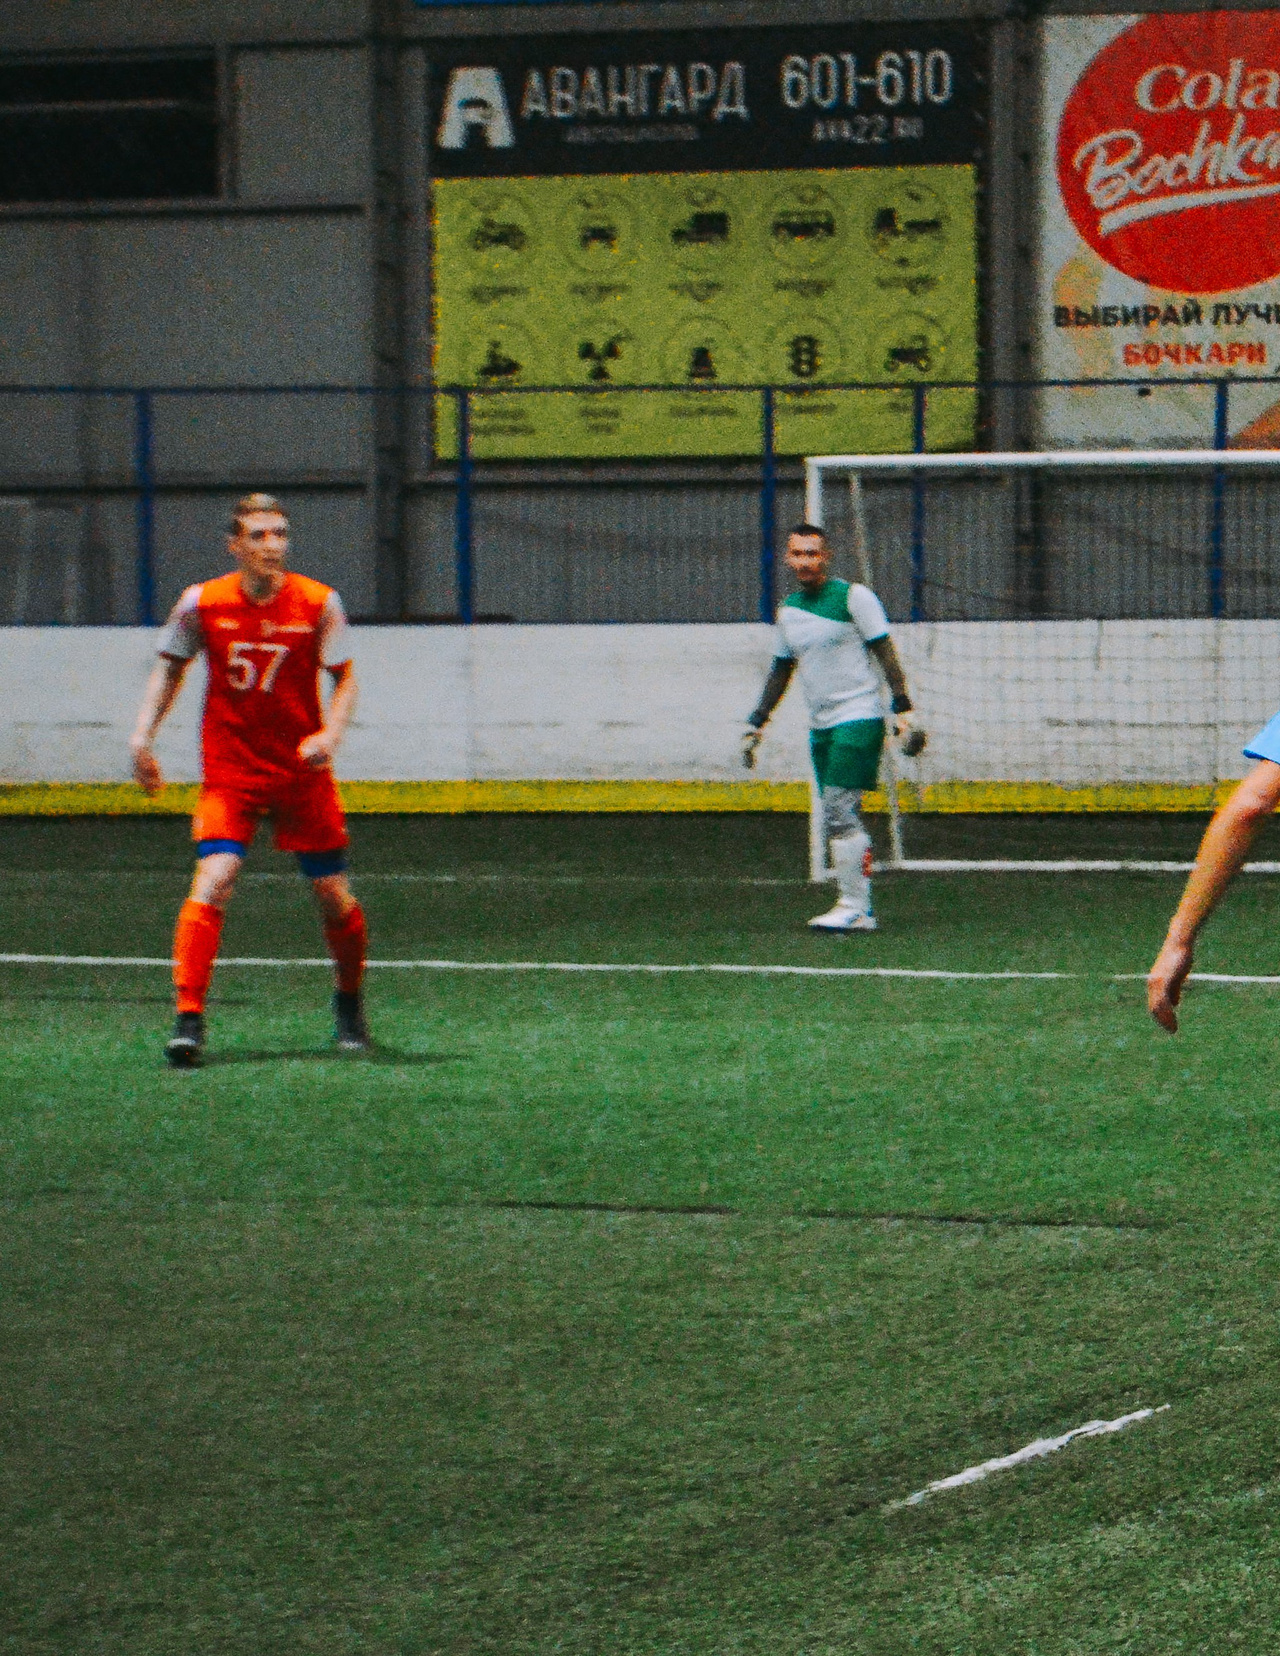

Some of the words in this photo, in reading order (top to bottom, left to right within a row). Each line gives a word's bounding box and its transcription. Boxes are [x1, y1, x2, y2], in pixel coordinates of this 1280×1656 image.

[521, 61, 748, 121] АВАНГАРД
[781, 49, 952, 108] 601-610
[1135, 57, 1280, 113] Cola
[1053, 299, 1201, 327] ВЫБИРАЙ
[1123, 342, 1267, 367] БОЧКАРИ
[227, 641, 290, 693] 57
